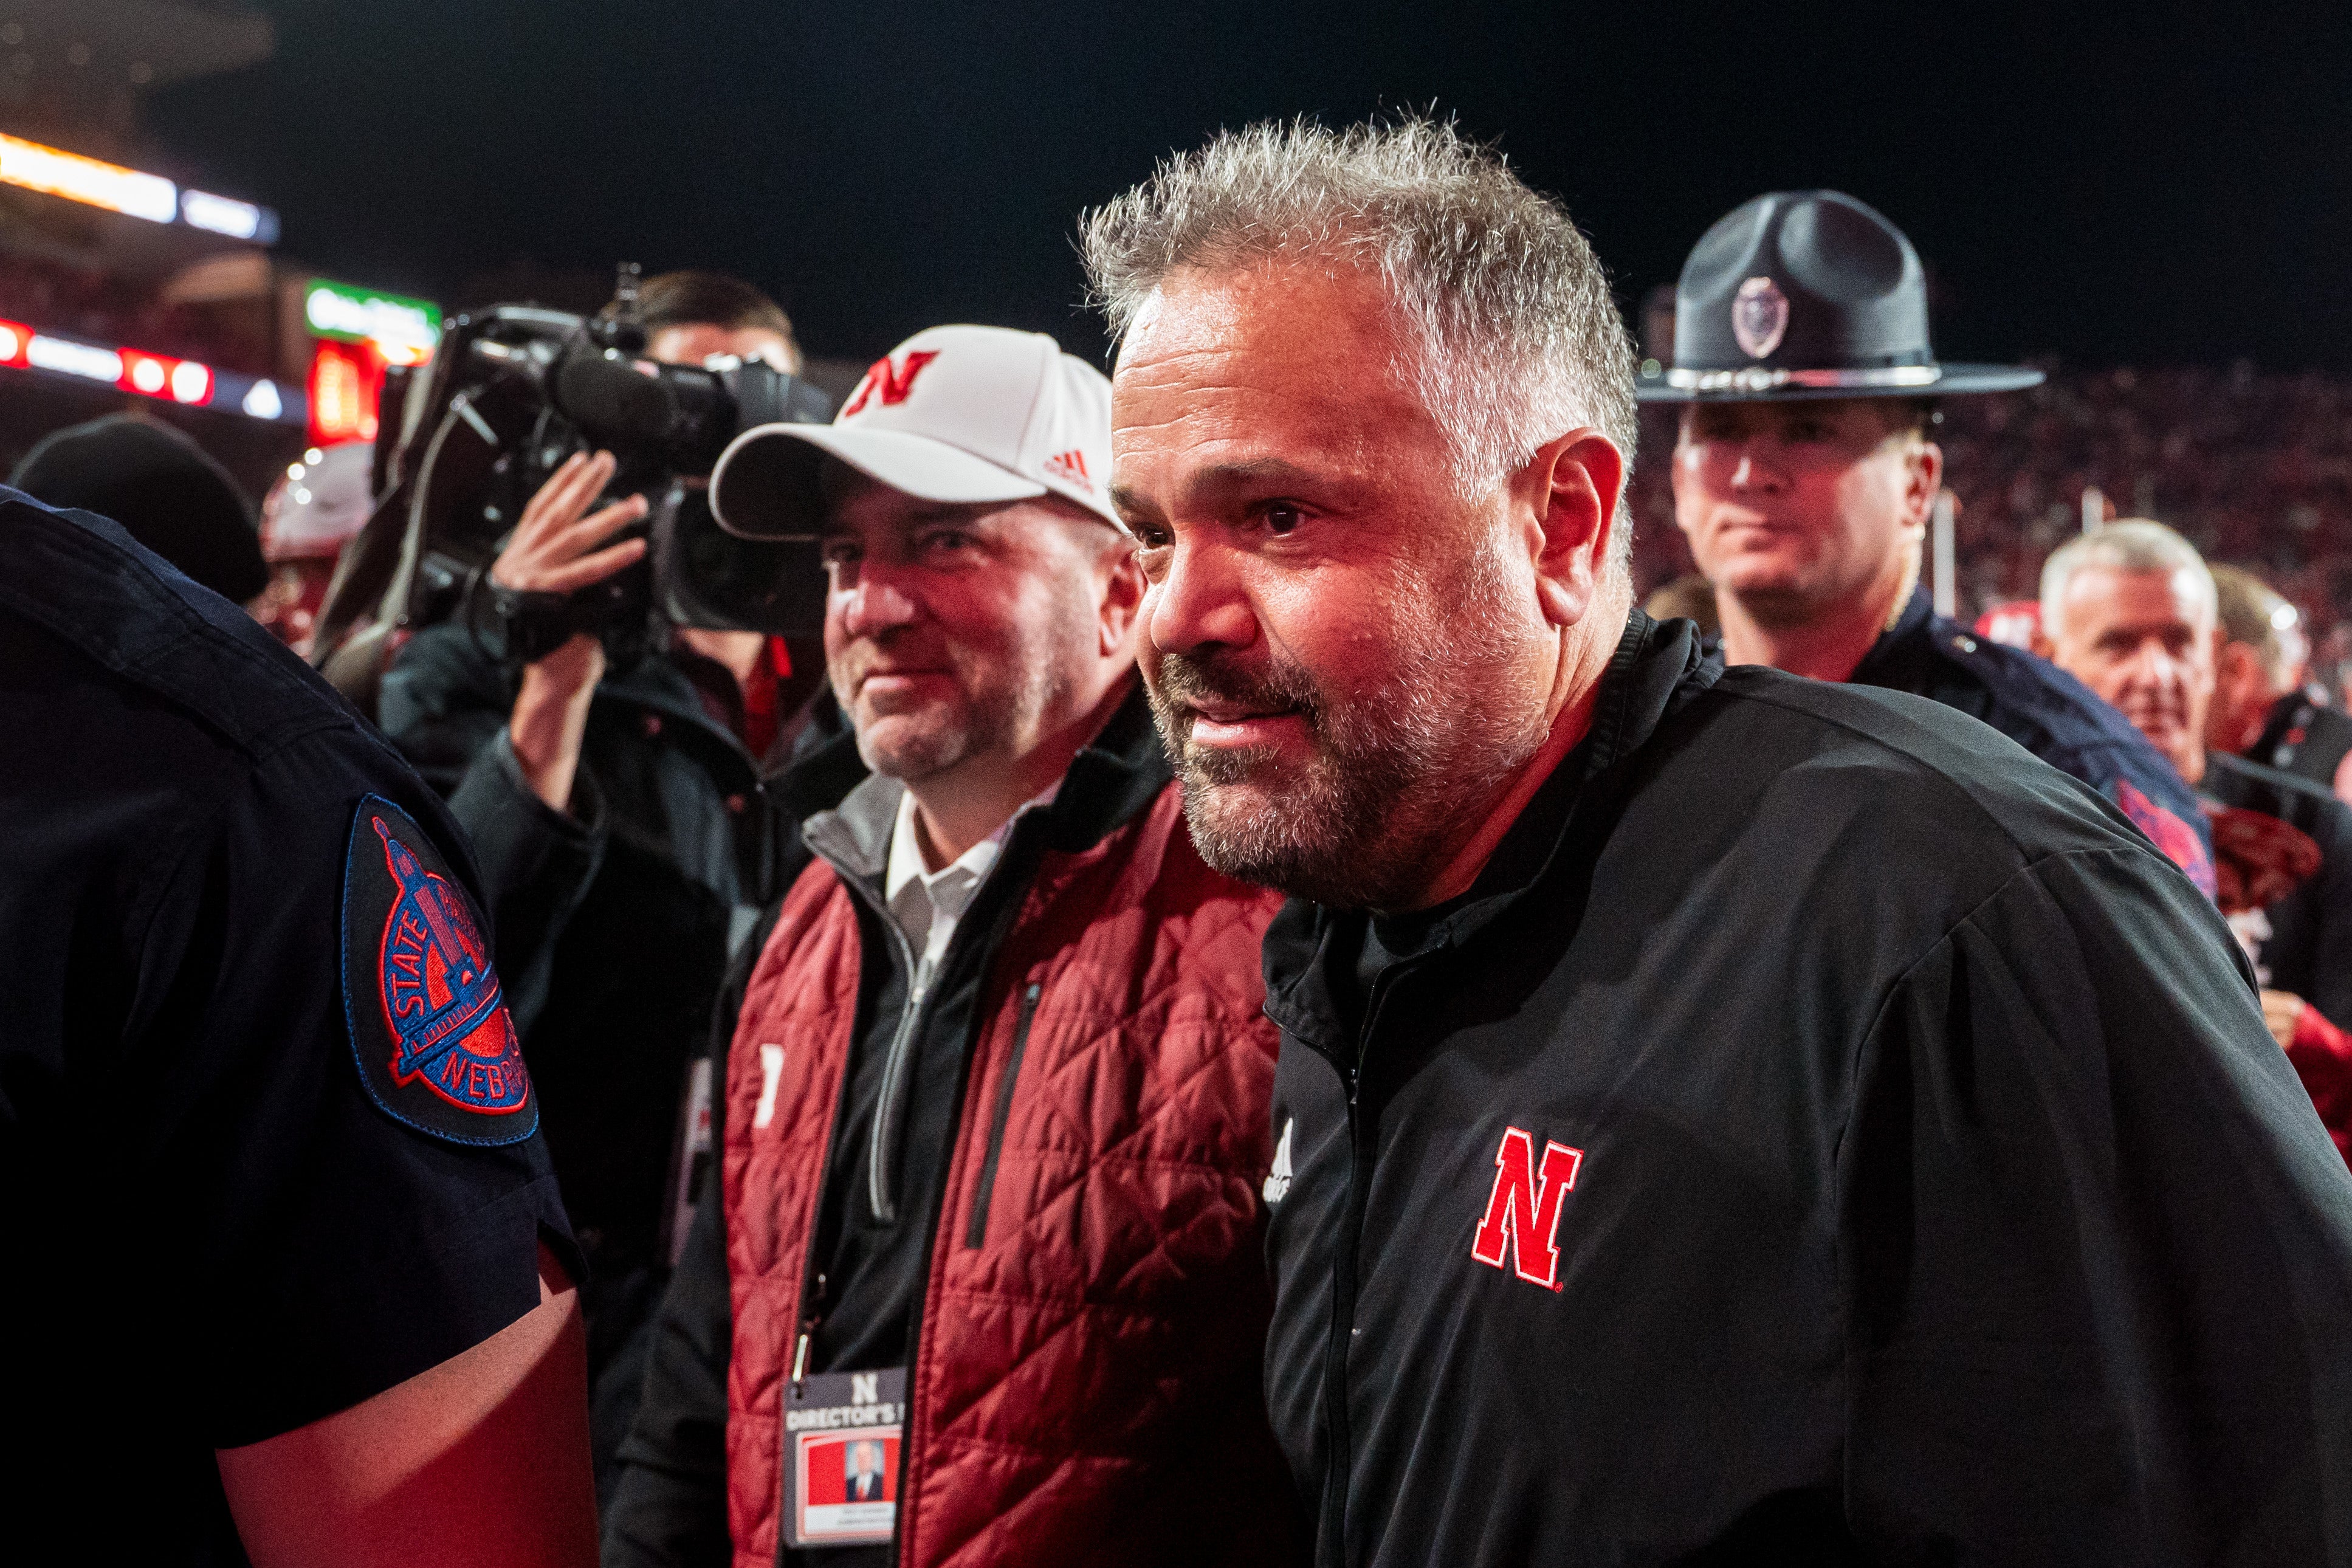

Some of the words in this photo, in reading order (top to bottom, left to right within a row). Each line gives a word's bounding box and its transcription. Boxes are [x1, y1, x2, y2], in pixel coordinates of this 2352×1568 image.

[845, 350, 941, 418] N
[392, 909, 428, 1019] STATE
[1471, 1126, 1584, 1290] N
[852, 1373, 878, 1405] N
